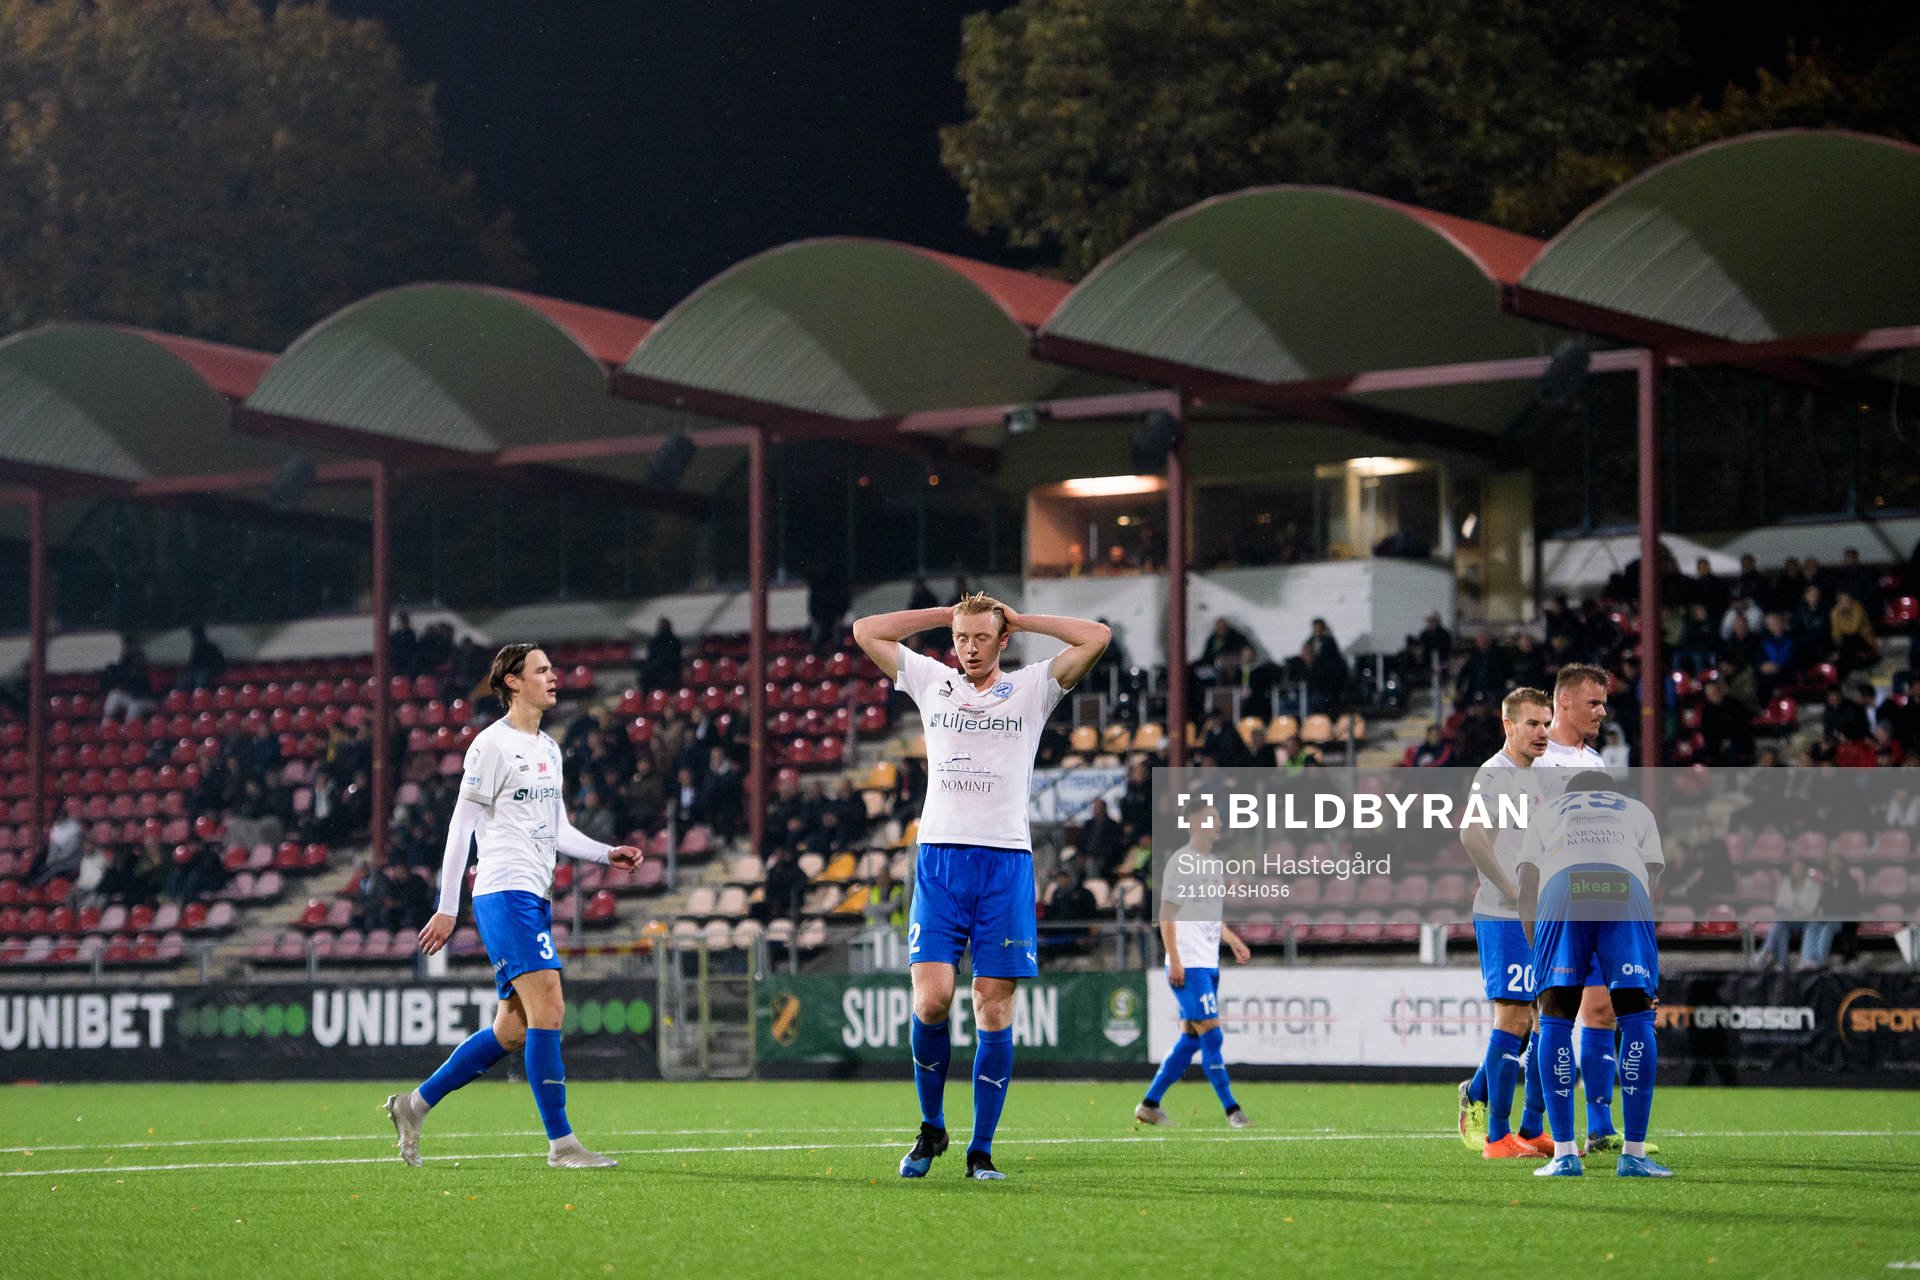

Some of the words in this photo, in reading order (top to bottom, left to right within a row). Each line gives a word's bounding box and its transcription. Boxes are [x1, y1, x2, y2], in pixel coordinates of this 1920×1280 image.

[943, 713, 1022, 733] Liljedahl
[537, 763, 547, 772] 3M
[941, 779, 994, 793] NOMINIT
[1567, 836, 1624, 847] KOMMUN
[1571, 879, 1611, 893] akea
[536, 932, 554, 960] 3
[1507, 963, 1535, 993] 20
[1199, 992, 1218, 1016] 13
[1222, 996, 1332, 1034] EATOR
[1390, 997, 1495, 1036] CREA
[0, 993, 174, 1049] UNIBET
[312, 988, 499, 1047] UNIBET
[842, 987, 1058, 1048] SUPEAN
[1657, 1005, 1815, 1030] RTGROSSEN
[1554, 1047, 1570, 1086] office
[1621, 1041, 1645, 1081] office
[1555, 1088, 1569, 1098] 4
[1623, 1085, 1637, 1096] 4
